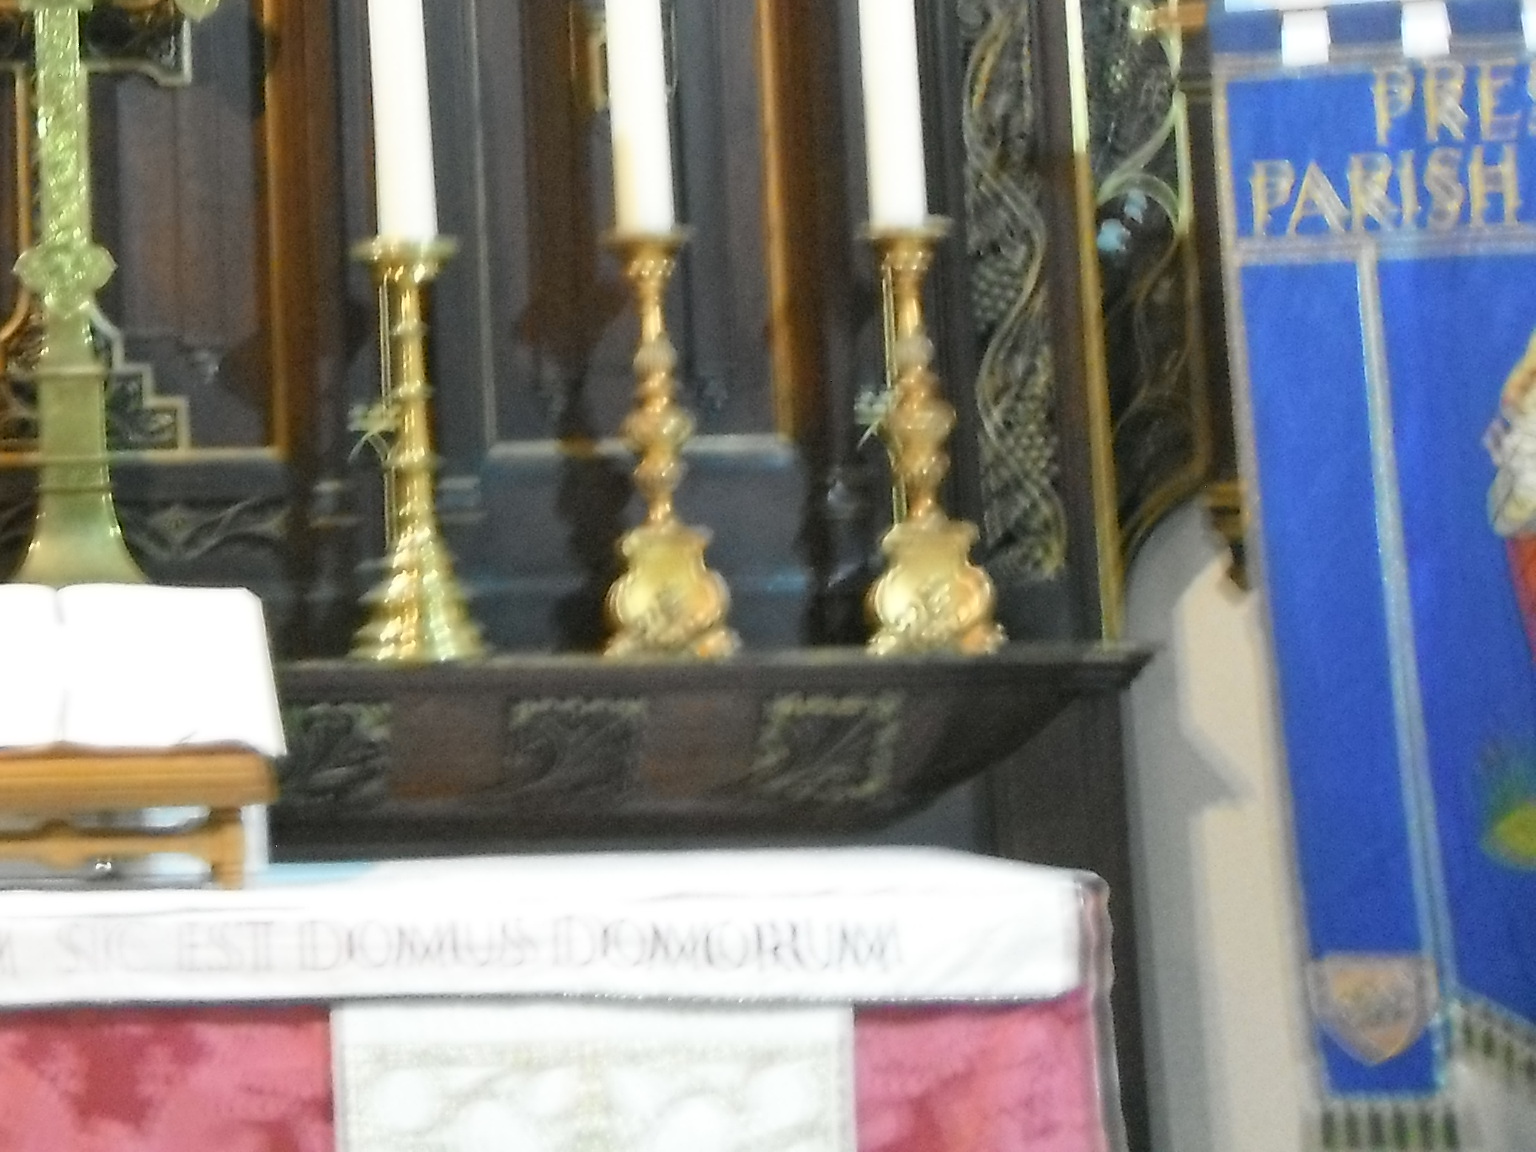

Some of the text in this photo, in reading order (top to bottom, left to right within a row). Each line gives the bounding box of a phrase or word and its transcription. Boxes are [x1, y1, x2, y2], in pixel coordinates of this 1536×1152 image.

[1371, 60, 1536, 146] PRE
[1250, 145, 1521, 237] PARISH
[176, 920, 274, 971] EST
[299, 918, 536, 969] DOMUS
[552, 914, 902, 972] DOMORUM
